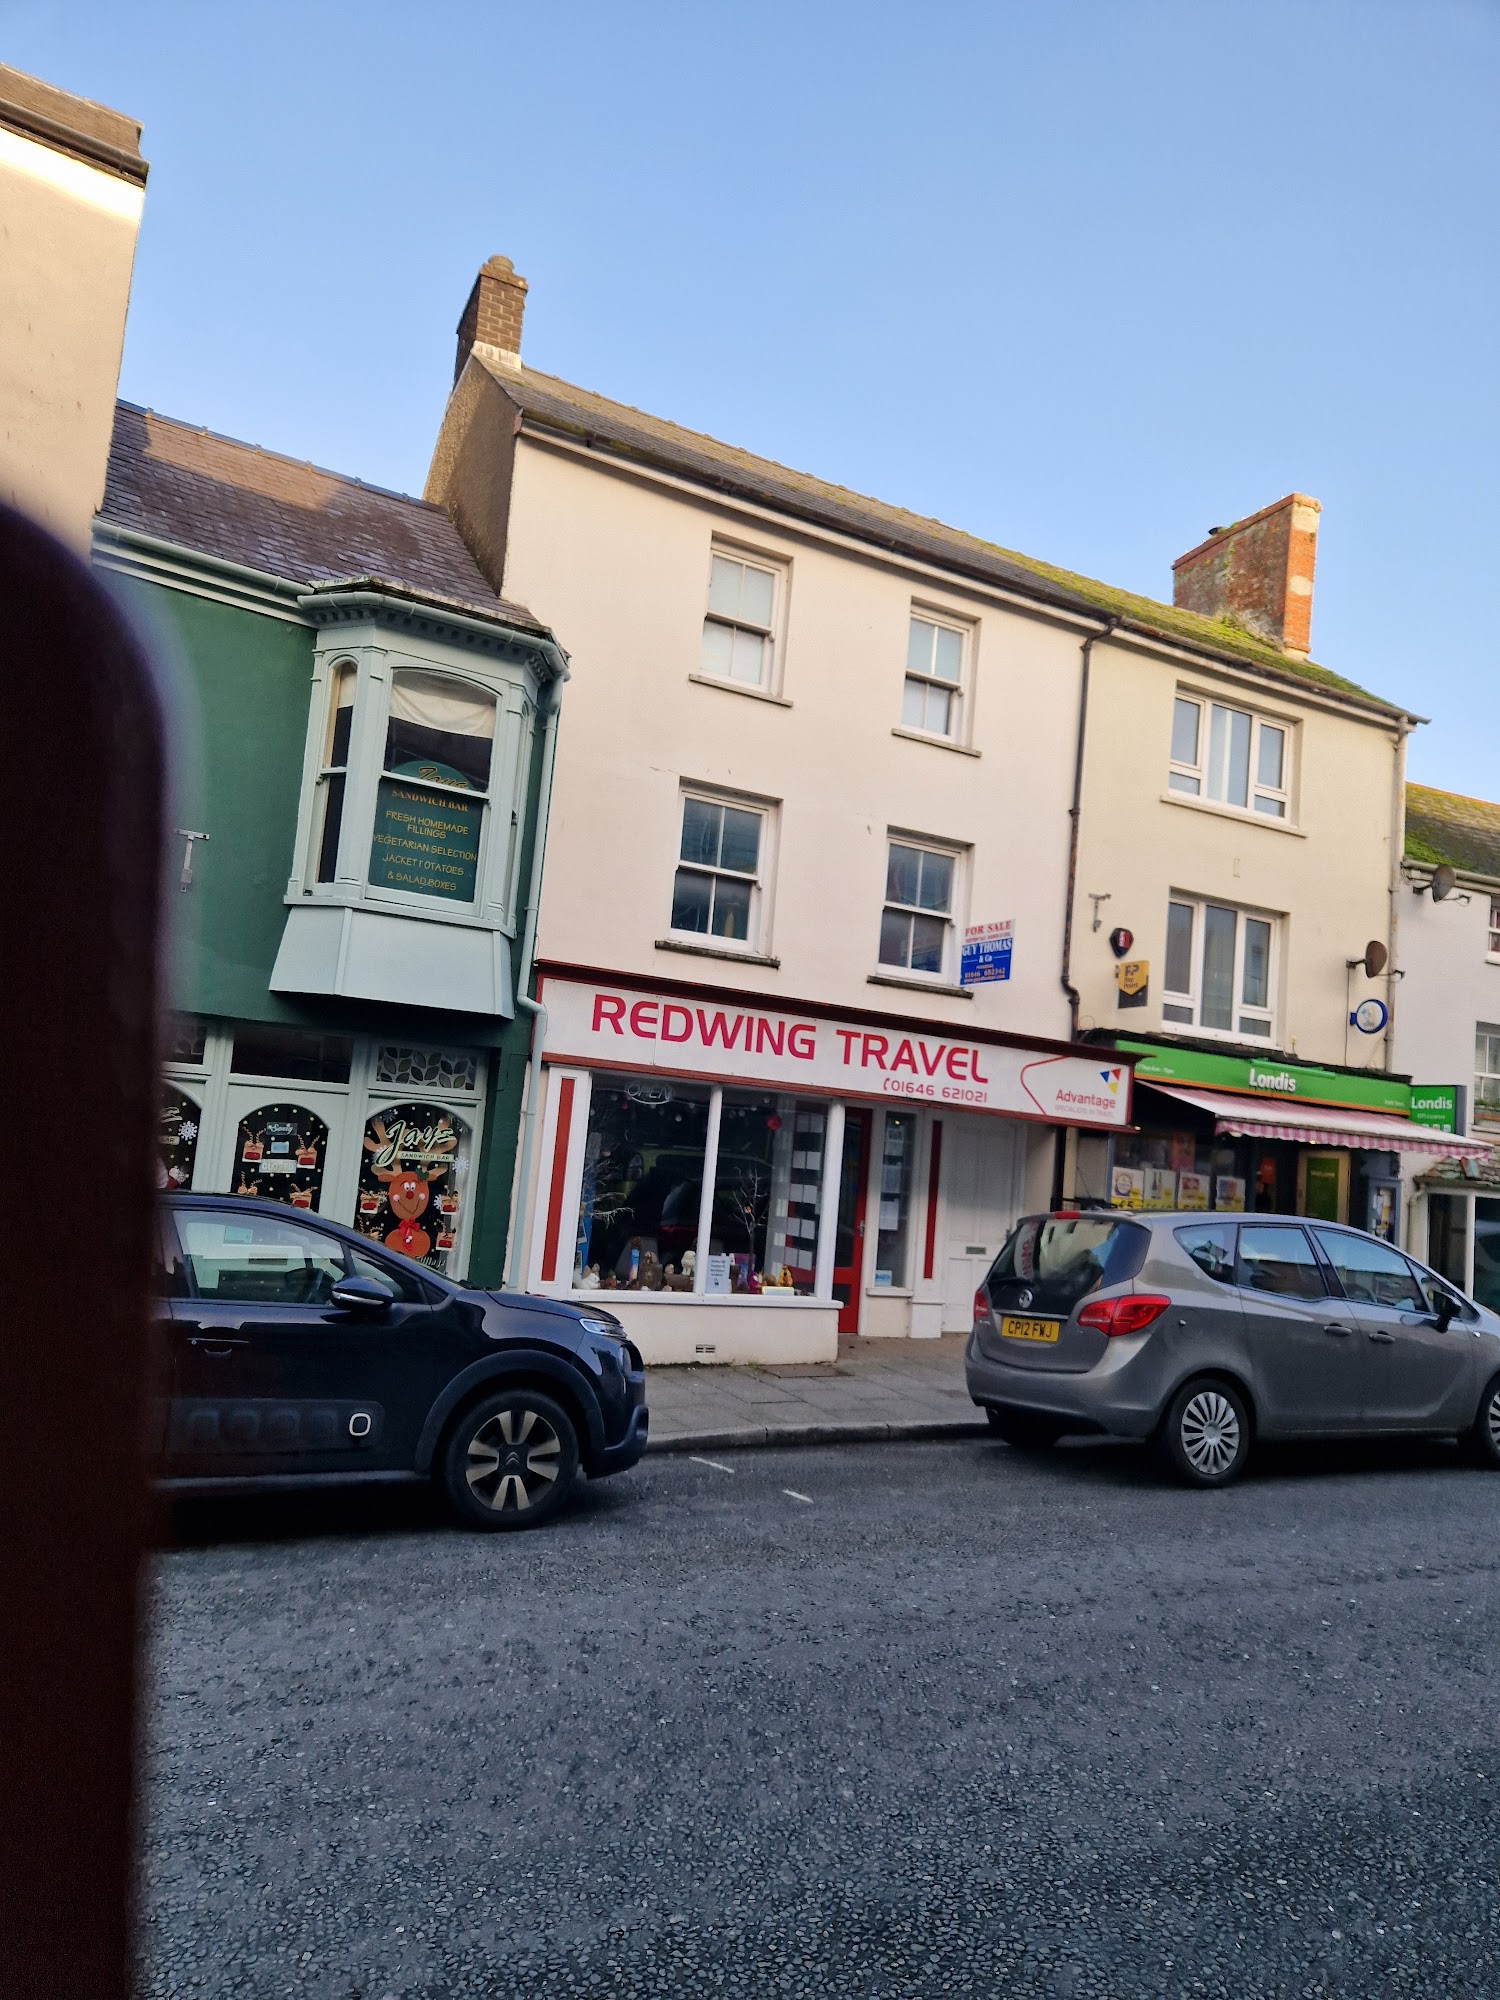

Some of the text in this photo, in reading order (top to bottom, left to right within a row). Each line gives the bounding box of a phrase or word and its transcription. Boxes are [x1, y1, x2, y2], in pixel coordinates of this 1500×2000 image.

[391, 789, 469, 812] SANDWICH BAR
[385, 810, 469, 835] FRESH HOMEMADE
[407, 824, 447, 839] FILLINGS
[373, 835, 477, 861] VEGETARIAN SELECTION
[383, 853, 418, 868] JACKET
[387, 871, 457, 891] & SALAD BOXES
[965, 920, 1012, 936] FOR SALE
[979, 938, 1012, 954] THOMAS
[591, 993, 988, 1084] REDWING TRAVEL
[1249, 1068, 1296, 1092] Londis
[891, 1080, 987, 1102] 01646 621021
[1056, 1089, 1116, 1109] Advantage
[1411, 1096, 1453, 1109] Londis
[262, 1161, 295, 1171] CLOSED
[1008, 1321, 1053, 1338] CP12 FWJ
